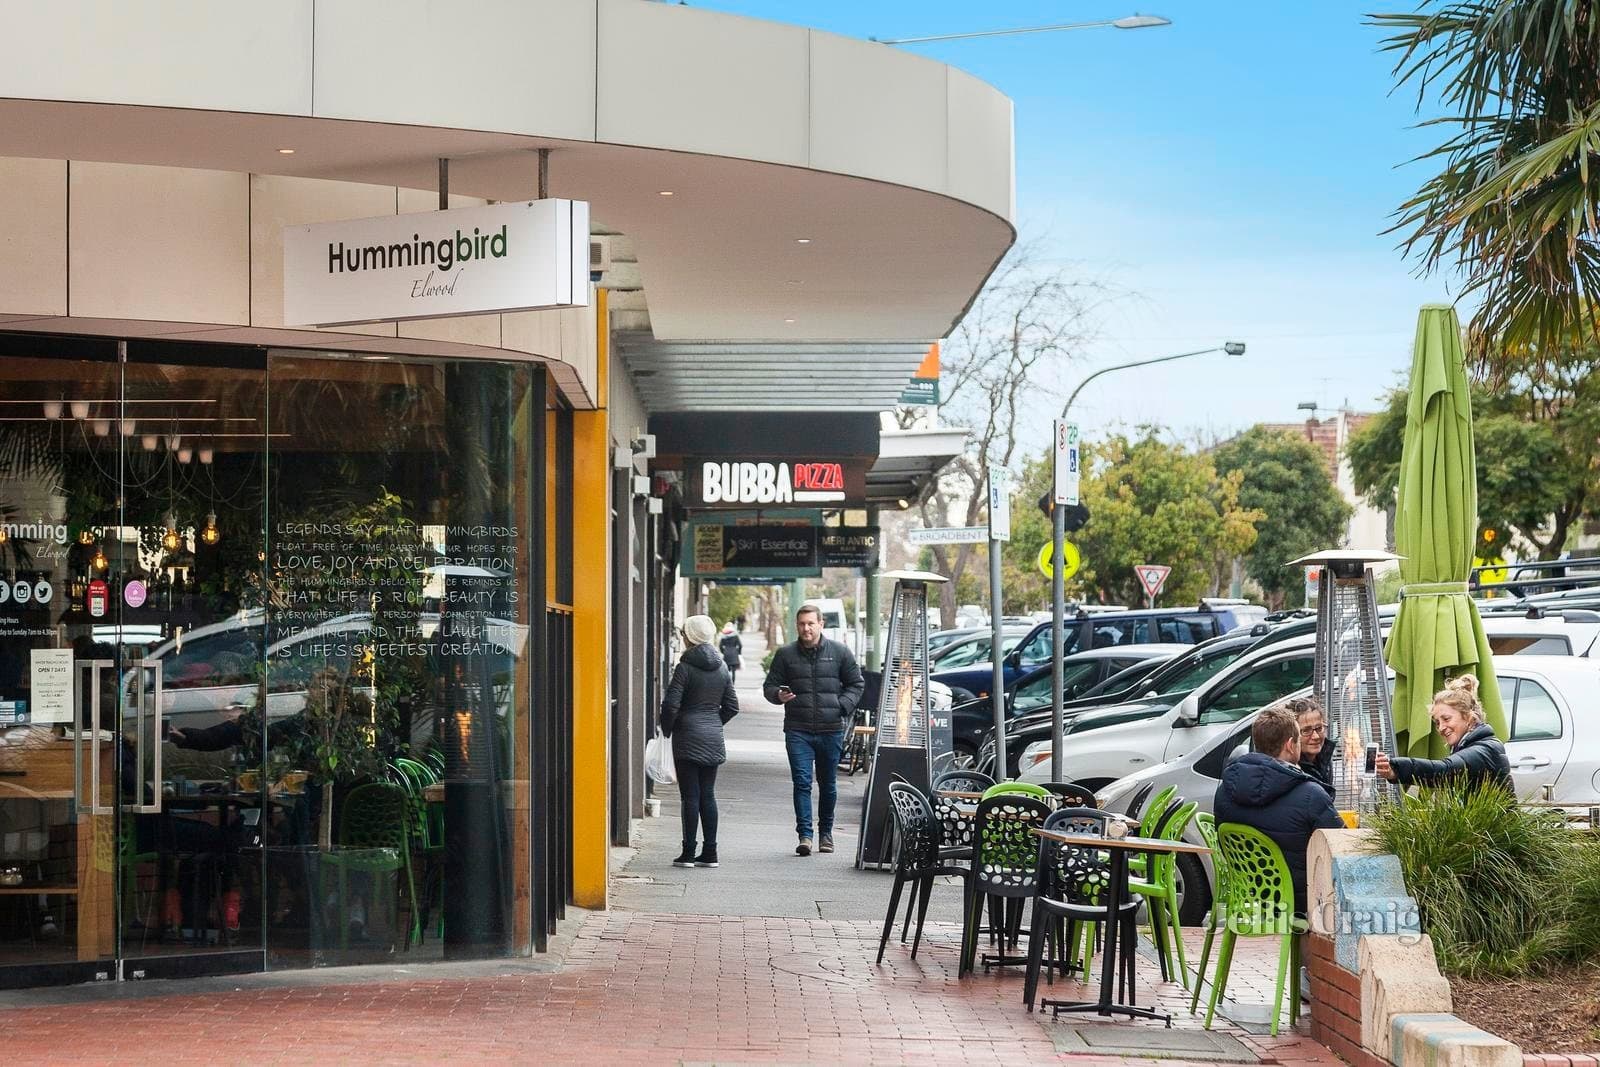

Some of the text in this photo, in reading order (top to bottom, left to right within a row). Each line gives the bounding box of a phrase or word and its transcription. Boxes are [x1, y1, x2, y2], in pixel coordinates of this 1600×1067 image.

[329, 224, 507, 273] Hummingbird
[410, 268, 464, 298] Elwood
[703, 461, 844, 503] BUBBA PIZZA
[277, 523, 519, 540] LEGENDS SAY THAT HMINGBIRDS
[276, 542, 306, 552] FLOAT
[313, 542, 336, 552] FREE
[342, 543, 355, 552] OF
[467, 544, 496, 553] HOPES
[502, 545, 520, 554] FOR
[278, 555, 326, 571] LOVE,
[328, 555, 360, 575] JOY
[362, 555, 399, 570] AND
[277, 577, 295, 587] THE
[381, 578, 420, 587] DELICATE
[462, 578, 502, 587] REMINDS
[507, 578, 519, 587] US
[277, 590, 321, 604] THAT
[328, 591, 359, 603] LIFE
[368, 591, 383, 603] IS
[505, 591, 519, 603] IS
[440, 610, 496, 619] CONNECTION
[501, 610, 520, 619] HAS
[356, 626, 389, 638] AND
[276, 645, 292, 657] IS
[299, 643, 347, 658] LIFE'S
